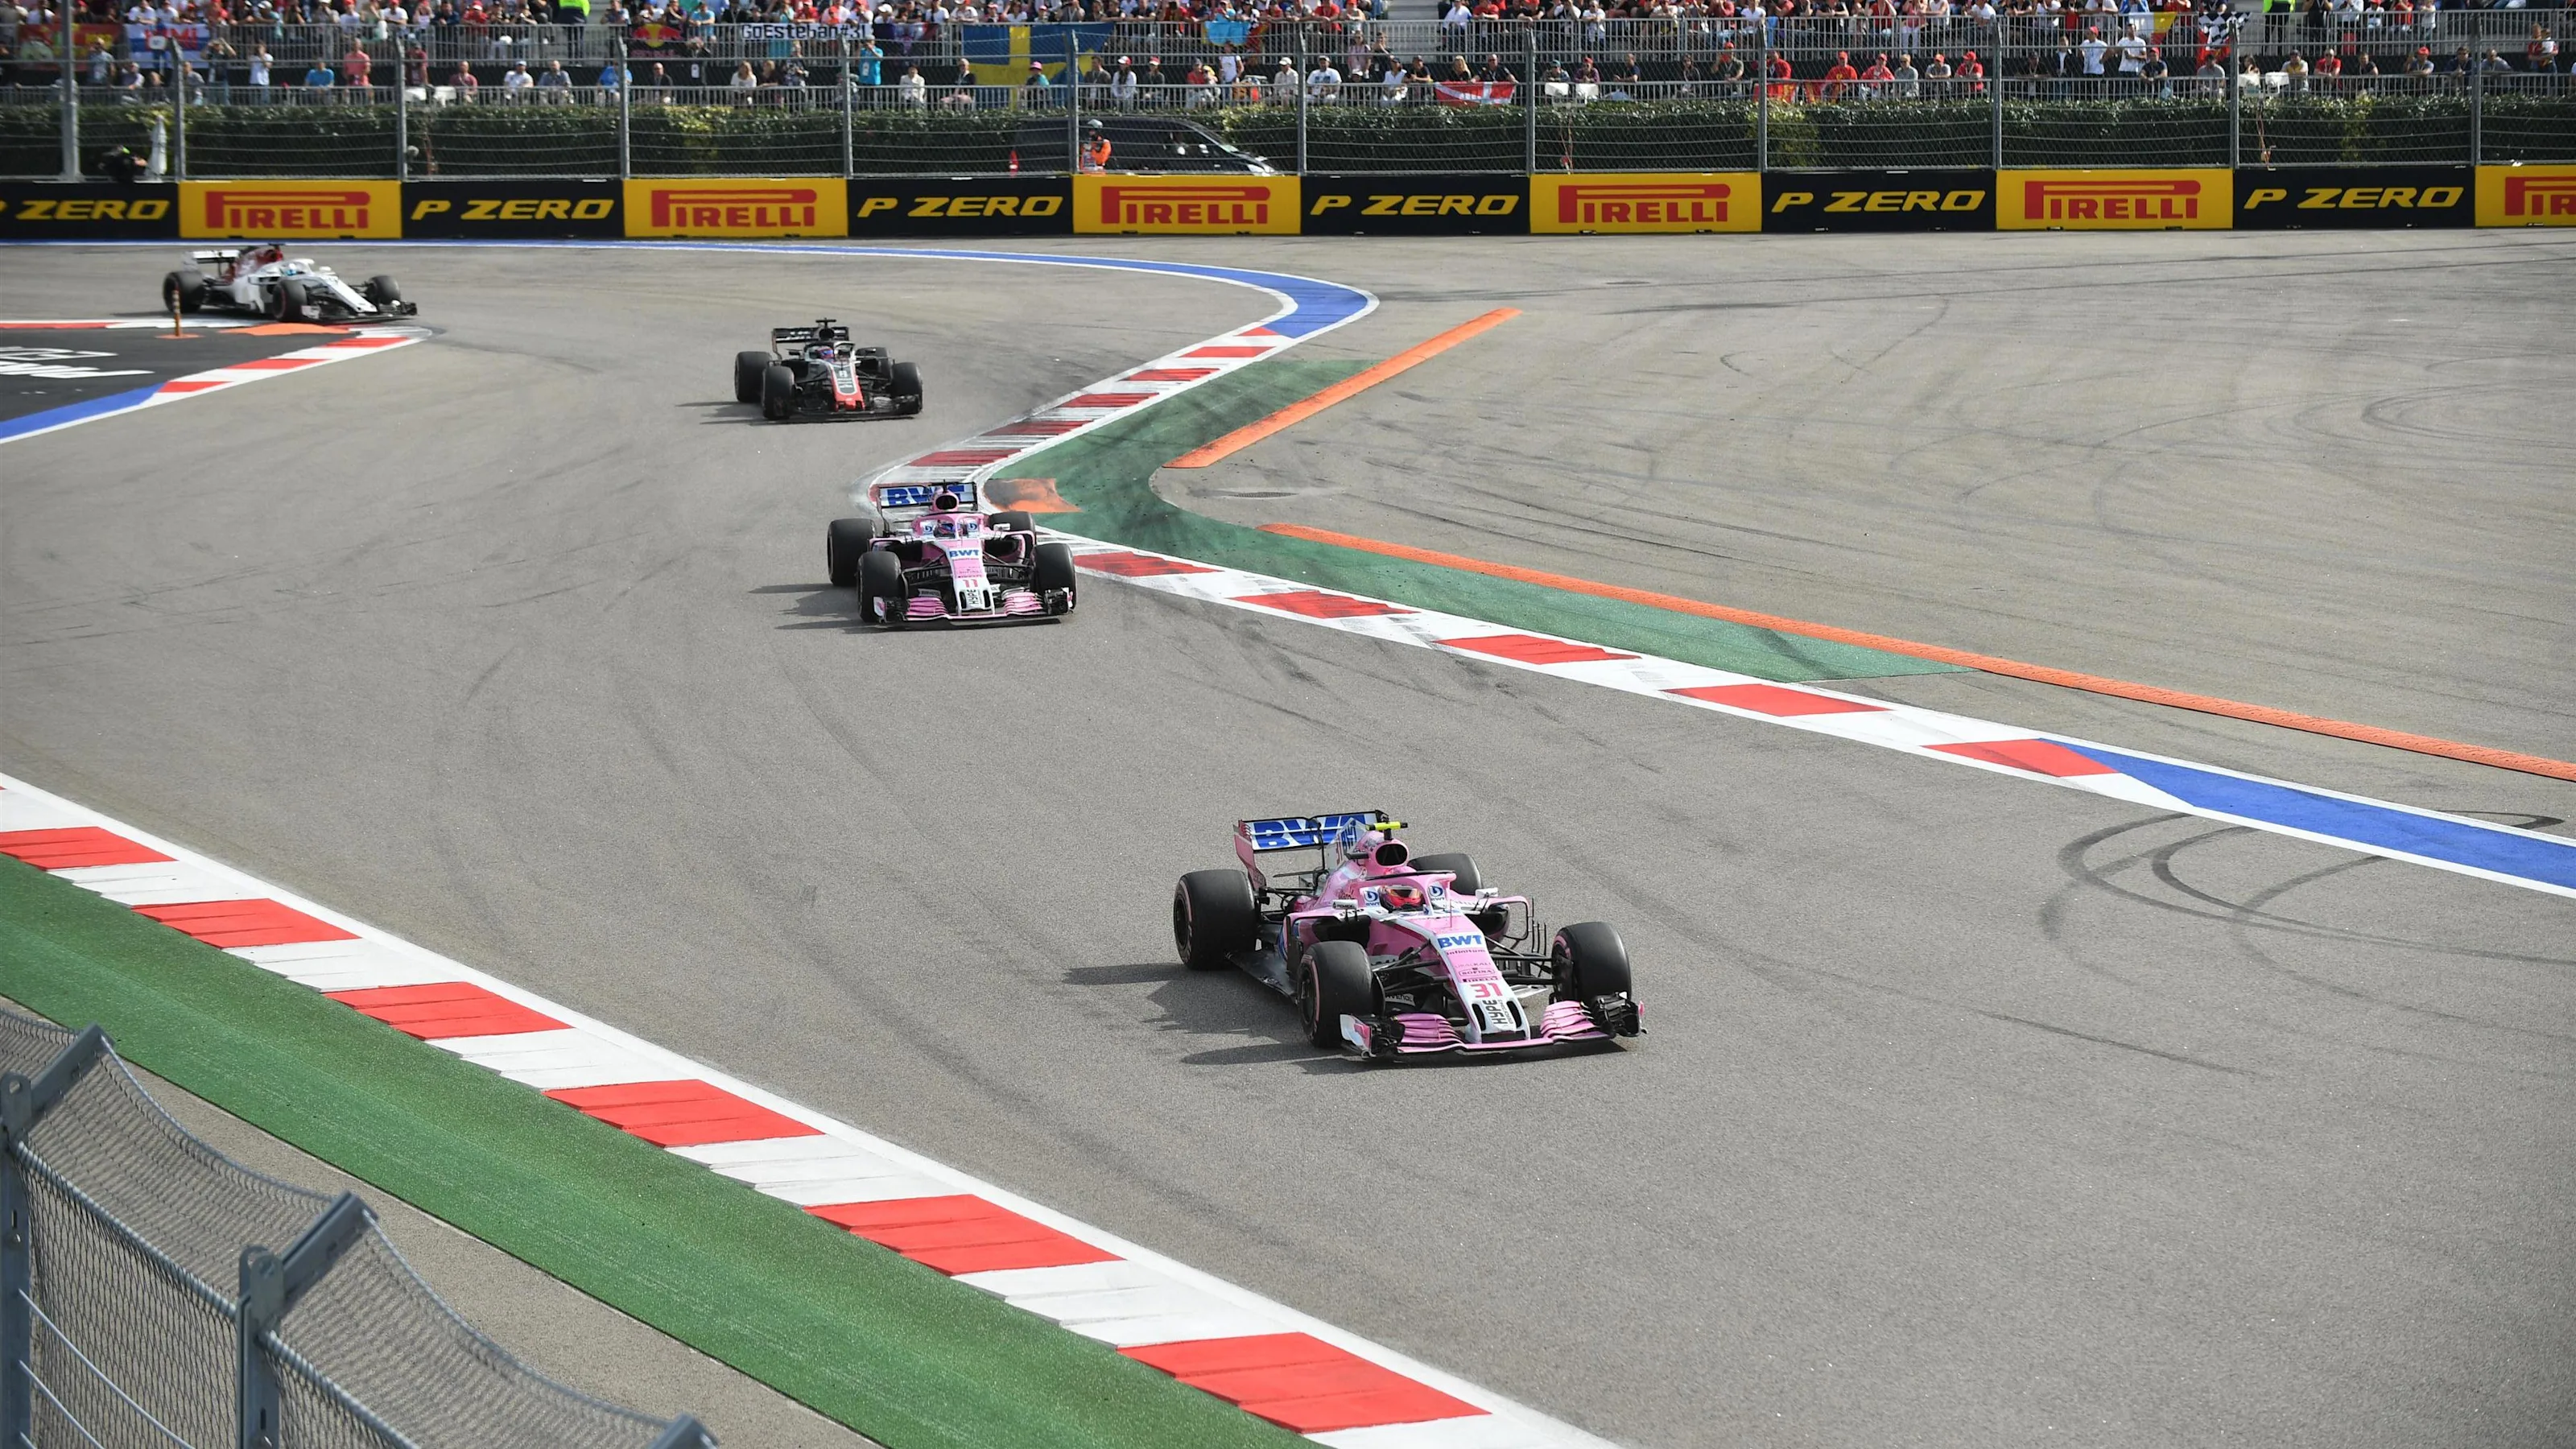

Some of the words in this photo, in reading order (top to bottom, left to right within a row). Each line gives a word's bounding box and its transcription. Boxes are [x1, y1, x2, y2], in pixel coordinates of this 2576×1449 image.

[652, 189, 817, 227] PIRELLI
[858, 198, 898, 217] P
[908, 196, 1063, 217] ZERO
[1101, 187, 1270, 224] PIRELLI
[1311, 196, 1352, 215] P
[1361, 195, 1519, 215] ZERO
[1558, 184, 1731, 223] PIRELLI
[1773, 192, 1814, 213] P
[1825, 190, 1986, 212] ZERO
[2025, 180, 2201, 219] PIRELLI
[2244, 188, 2287, 208] P
[2298, 187, 2463, 208] ZERO
[22, 200, 168, 219] ZERO
[206, 192, 370, 229] PIRELLI
[412, 200, 451, 220] P
[461, 199, 614, 220] ZERO
[949, 549, 979, 558] BWT
[963, 579, 978, 588] 11
[1437, 935, 1482, 948] BWT
[1470, 983, 1503, 998] 31
[1482, 1000, 1509, 1025] HYPE
